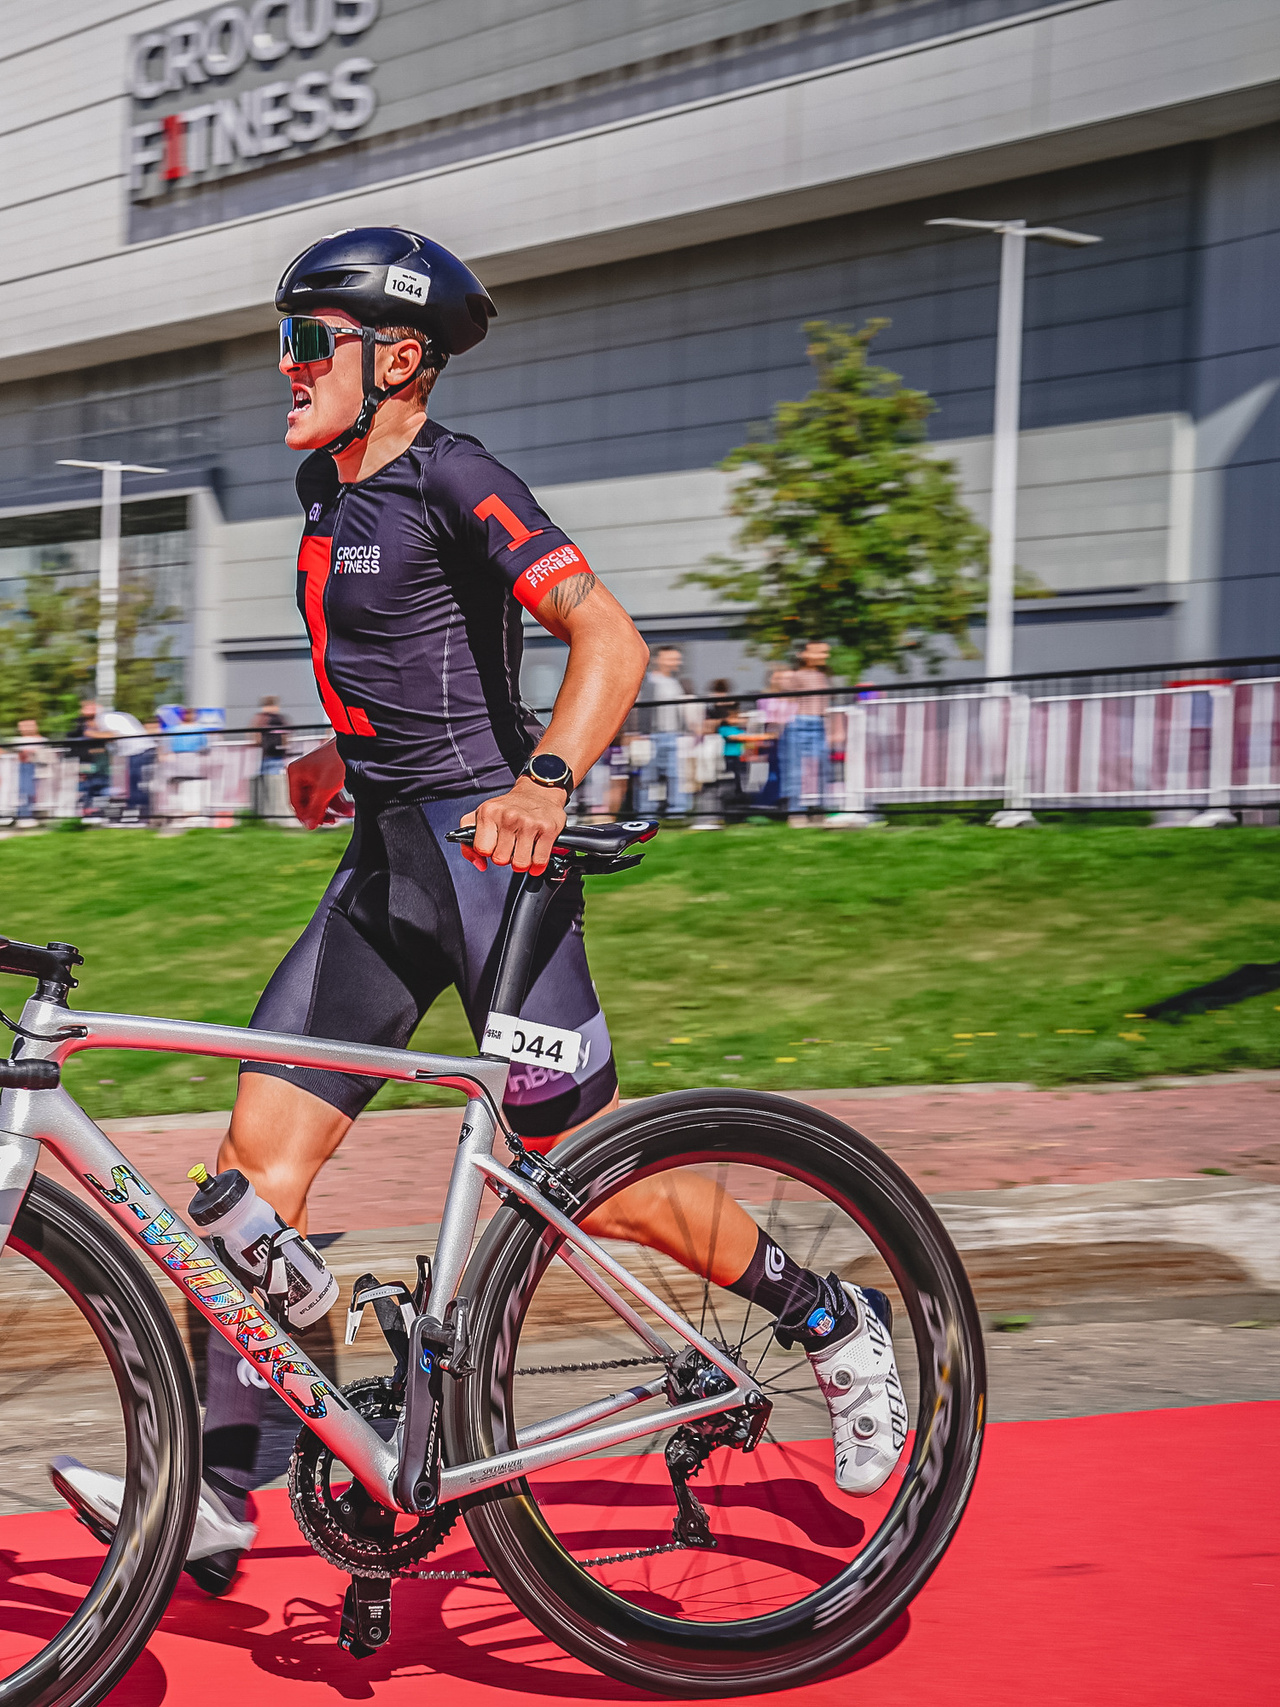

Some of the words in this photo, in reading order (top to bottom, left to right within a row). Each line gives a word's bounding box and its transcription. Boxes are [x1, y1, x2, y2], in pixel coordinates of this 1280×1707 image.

[392, 279, 423, 298] 1044
[336, 545, 381, 560] CROCUS
[525, 546, 574, 580] CROCUS
[84, 1165, 350, 1419] S-WORKS
[425, 1399, 441, 1478] ULTEGRA
